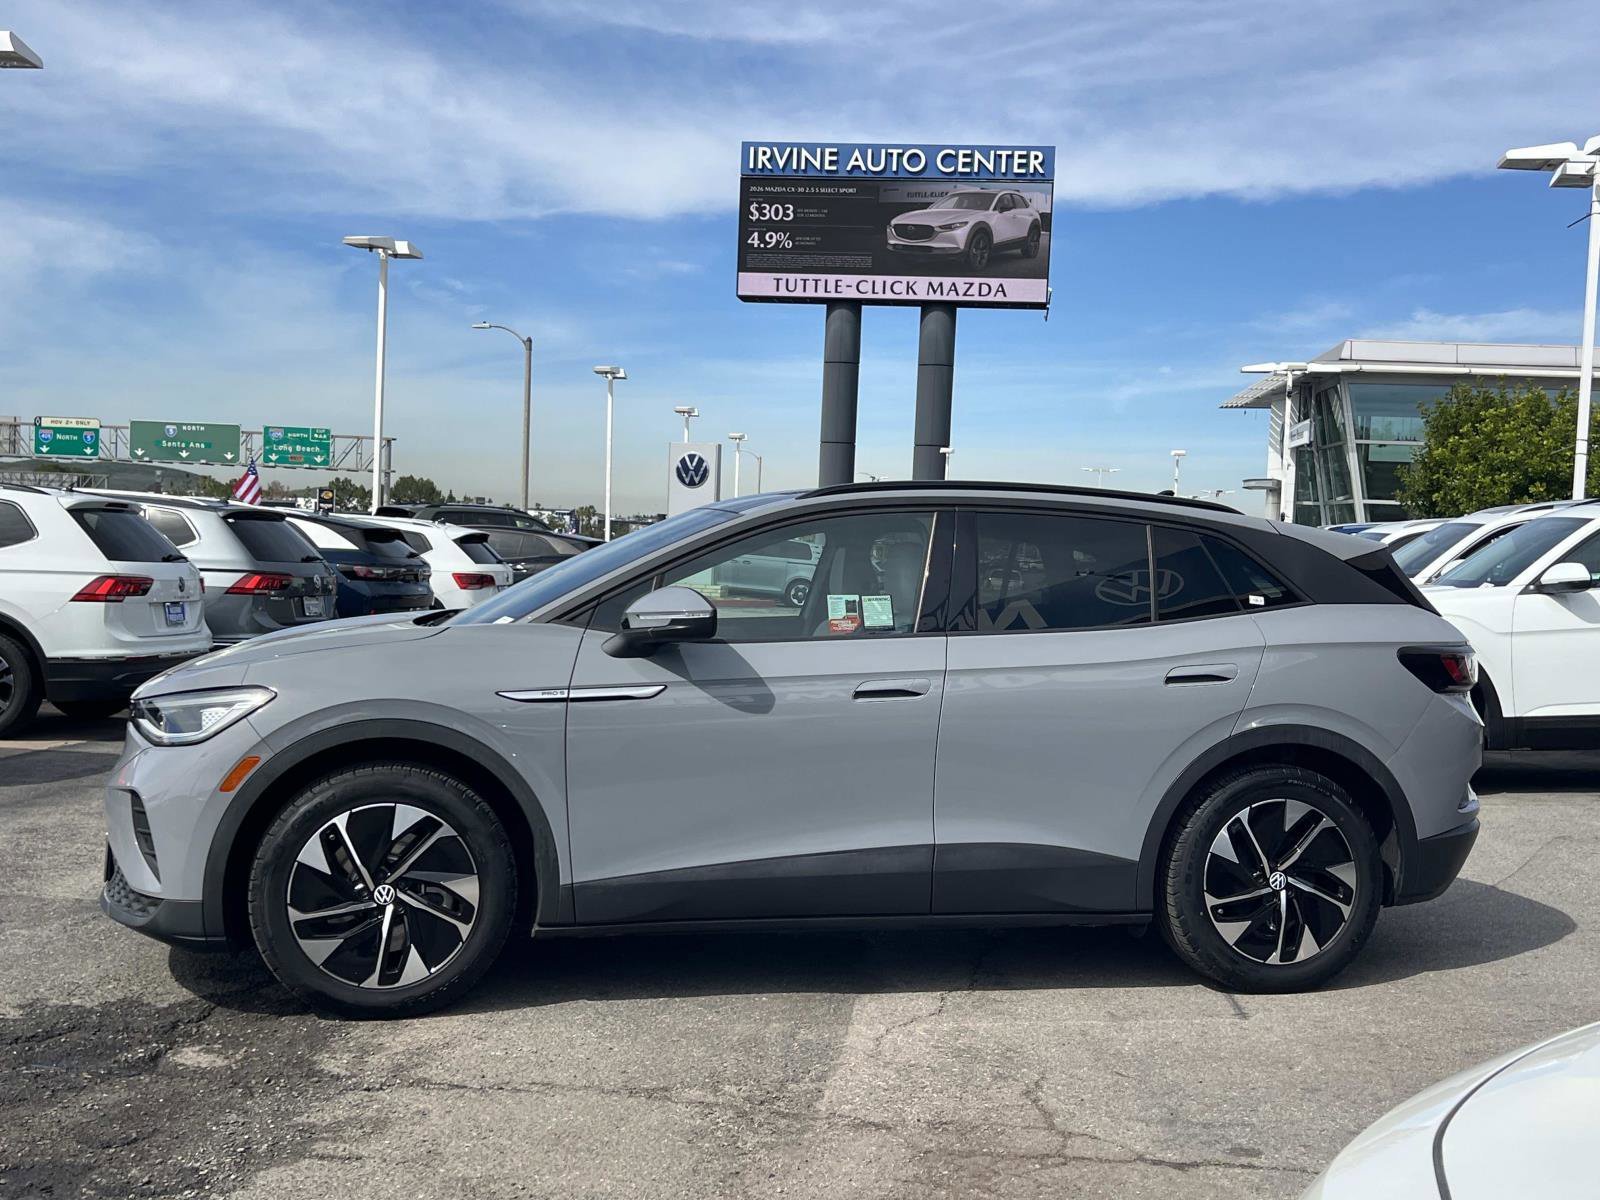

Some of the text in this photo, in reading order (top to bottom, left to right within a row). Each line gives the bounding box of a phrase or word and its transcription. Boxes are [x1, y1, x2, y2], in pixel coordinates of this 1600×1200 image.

[749, 146, 1045, 174] IRVINE AUTO CENTER
[748, 201, 794, 222] $303
[747, 231, 793, 249] 4.9%
[773, 277, 1008, 298] TUTTLE-CLICK MAZDA
[162, 440, 205, 449] Santa Ana
[273, 444, 320, 453] Long Beach
